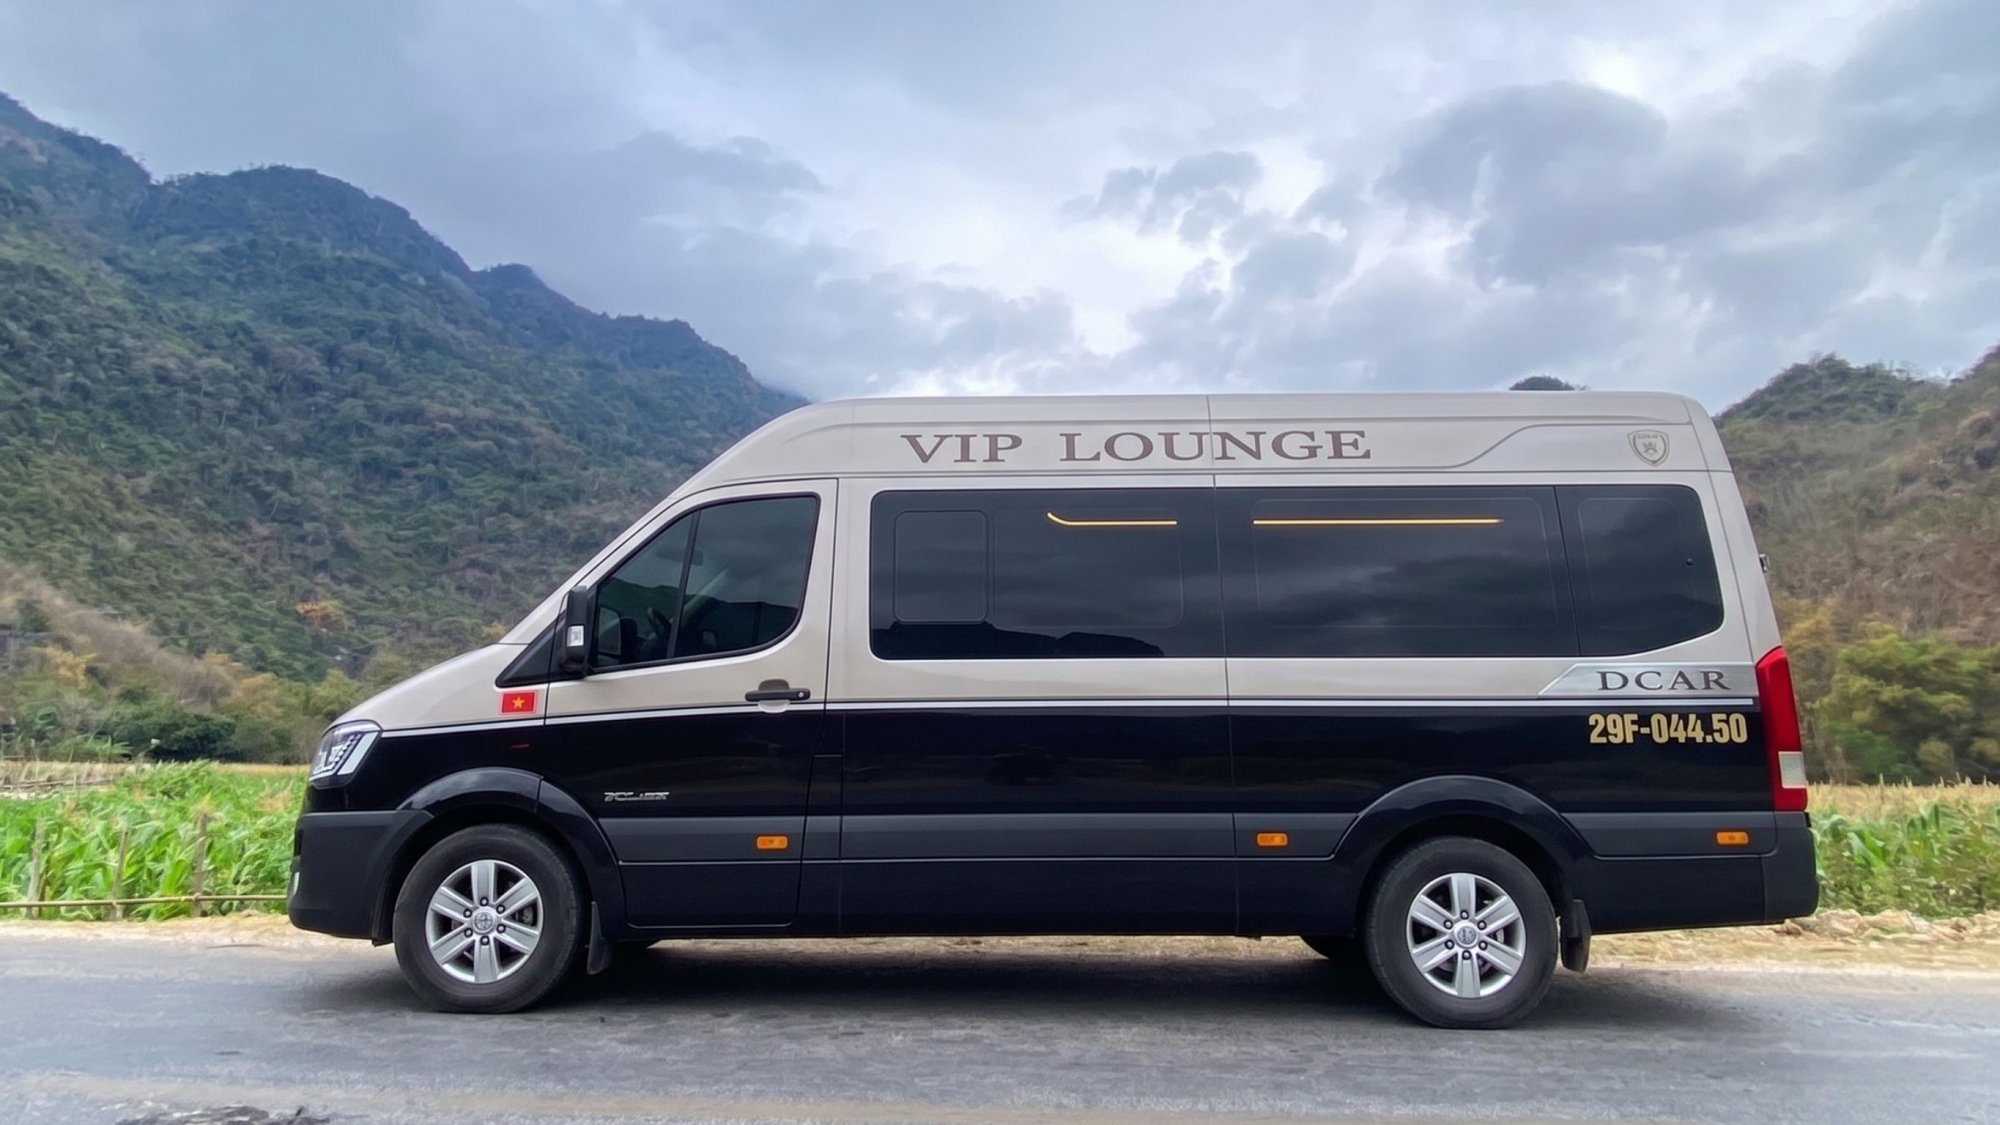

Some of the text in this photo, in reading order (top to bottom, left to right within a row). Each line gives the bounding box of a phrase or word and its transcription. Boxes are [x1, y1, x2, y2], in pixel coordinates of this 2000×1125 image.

[900, 430, 1372, 464] VIP LOUNGE
[1596, 670, 1731, 691] DCAR
[1588, 712, 1748, 744] 29F-044.50
